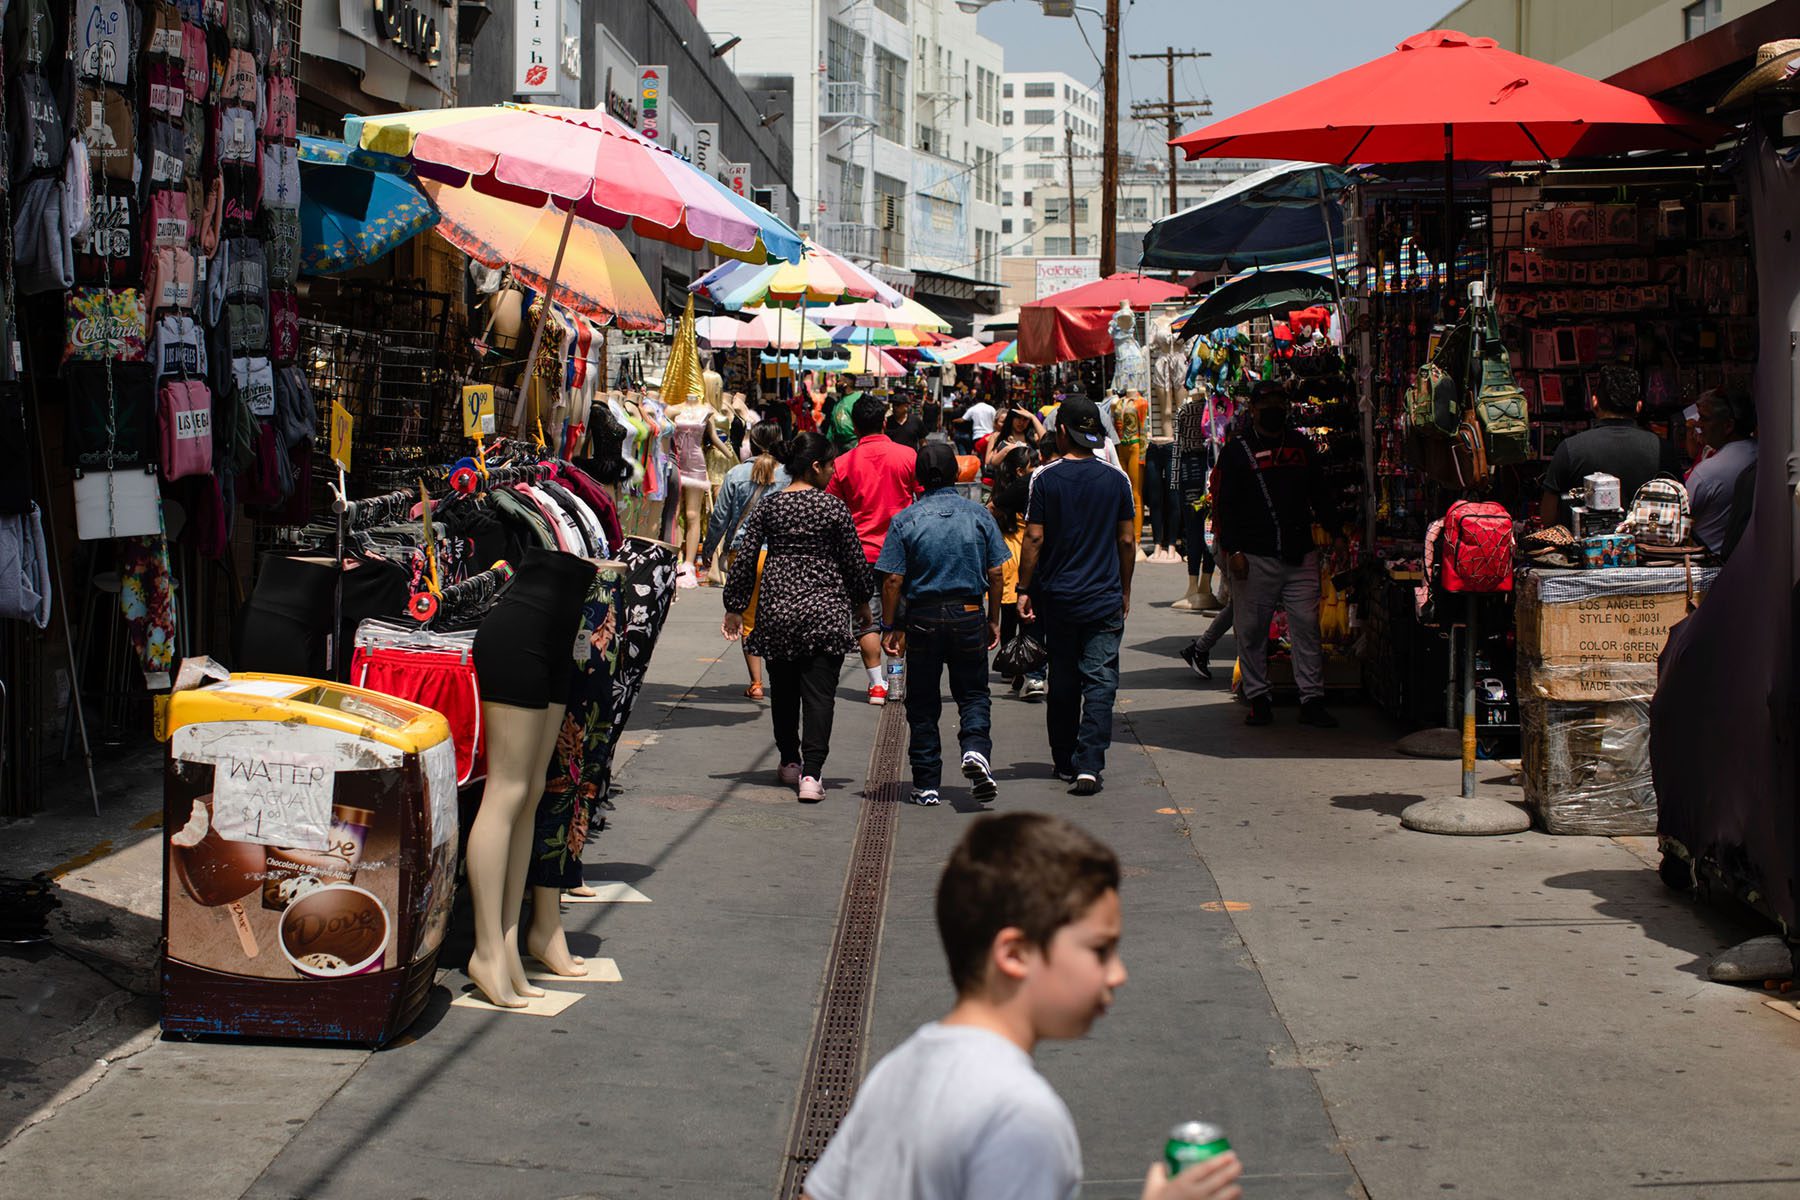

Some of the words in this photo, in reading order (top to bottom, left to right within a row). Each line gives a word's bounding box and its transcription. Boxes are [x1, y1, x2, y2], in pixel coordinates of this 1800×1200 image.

[641, 69, 660, 139] ACCESSO
[71, 316, 140, 347] Calirnia
[1578, 600, 1600, 610] LOS
[1606, 599, 1656, 610] ANGELES
[1578, 613, 1612, 624] STYLE
[1622, 653, 1633, 662] 16
[1638, 653, 1659, 663] PCS
[1580, 681, 1611, 691] MADE
[229, 758, 325, 788] WATER
[266, 857, 299, 870] Chocolate
[299, 864, 306, 872] &
[287, 908, 382, 945] Dove
